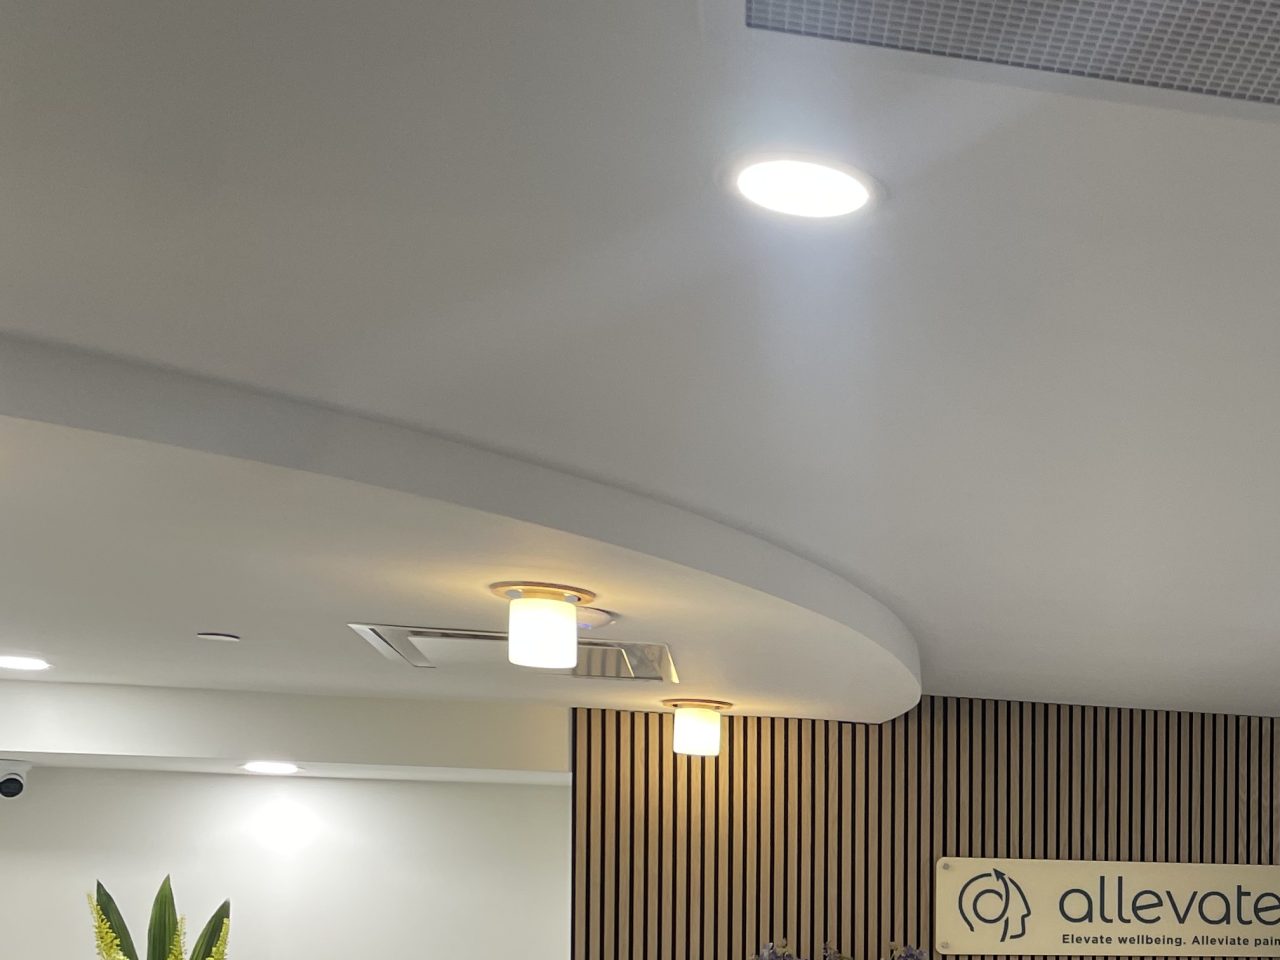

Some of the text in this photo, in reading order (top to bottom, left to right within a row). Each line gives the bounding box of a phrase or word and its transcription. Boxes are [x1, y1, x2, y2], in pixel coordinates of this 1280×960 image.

[1061, 933, 1113, 945] Elevate
[1117, 934, 1187, 947] wellbeing.
[1191, 935, 1250, 946] Alleviate
